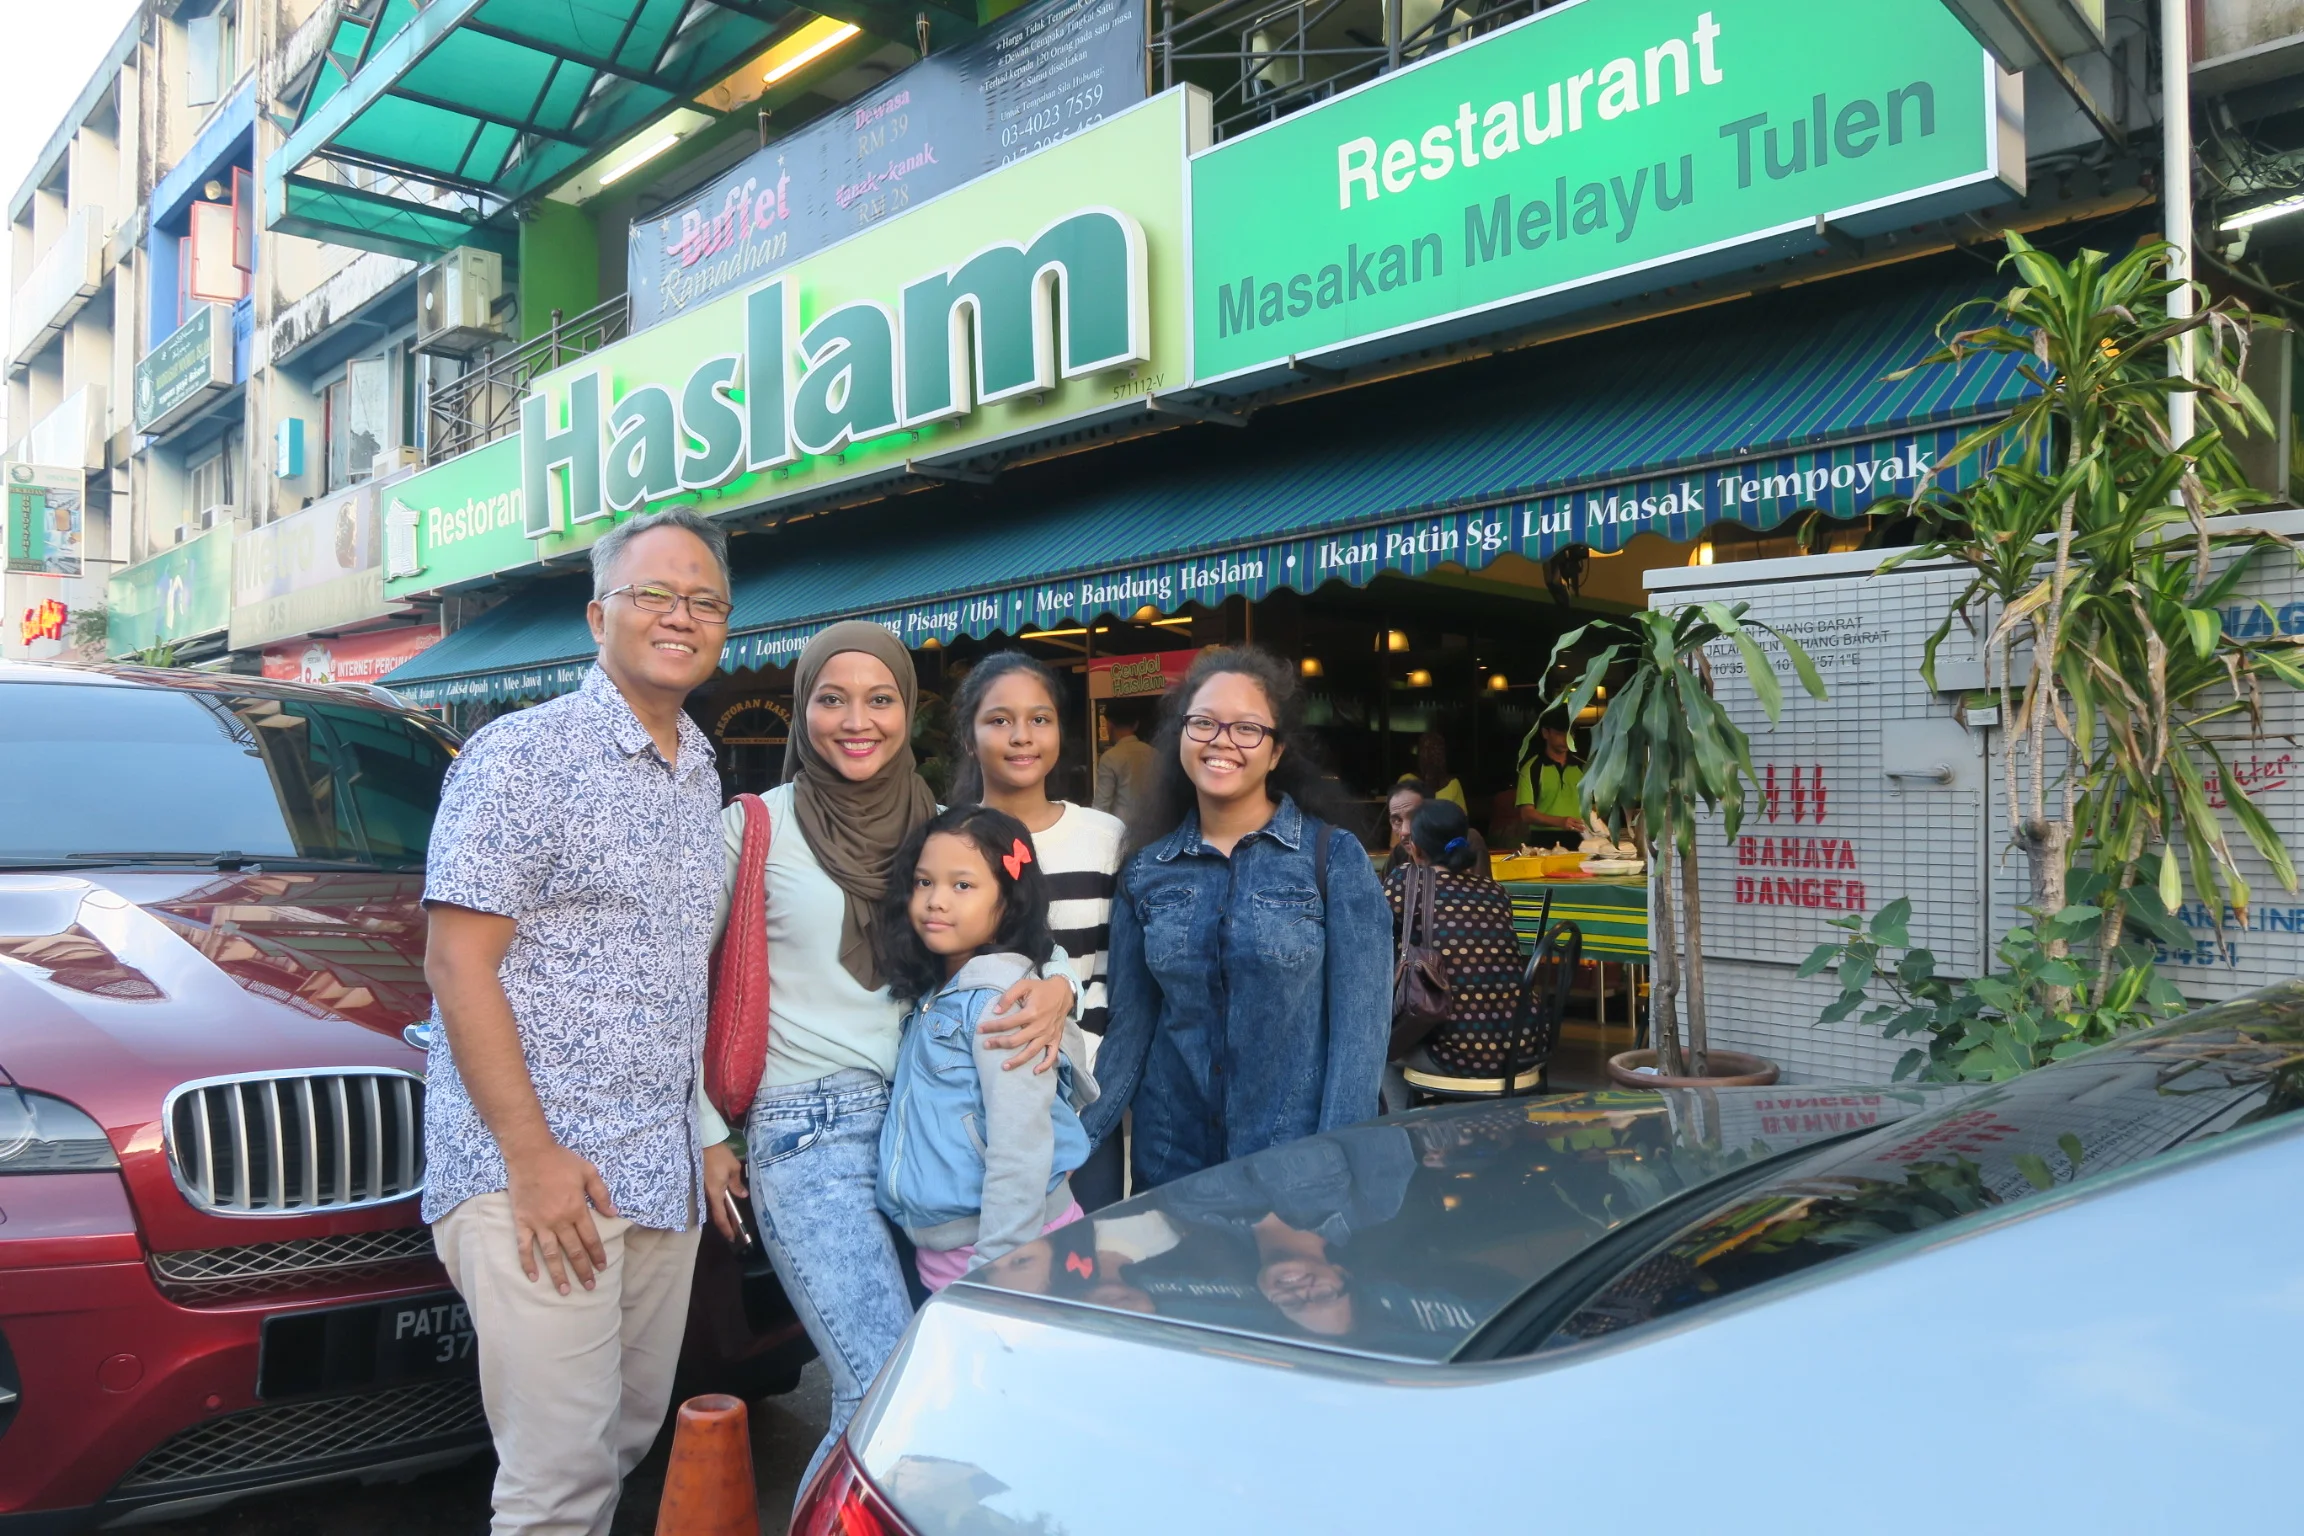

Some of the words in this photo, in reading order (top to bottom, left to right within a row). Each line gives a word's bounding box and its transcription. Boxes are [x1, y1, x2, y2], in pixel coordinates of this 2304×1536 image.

[1002, 34, 1023, 50] Harga
[1024, 20, 1046, 37] Tidak
[1047, 0, 1083, 25] Termasuk
[1004, 45, 1029, 65] Dewan
[1030, 29, 1065, 51] Cempaka
[1066, 13, 1094, 38] Tingkat
[1096, 3, 1114, 18] Satu
[984, 73, 1008, 91] Terhad
[1009, 58, 1034, 80] kepada
[1036, 51, 1049, 66] 120
[1050, 40, 1073, 58] Orang
[1074, 30, 1093, 49] pada
[1094, 22, 1110, 36] satu
[1112, 10, 1132, 28] masa
[1026, 70, 1047, 87] Surau
[1048, 51, 1088, 76] disediakan
[855, 90, 910, 130] Dewasa
[1000, 108, 1021, 122] Untuk
[1022, 89, 1056, 111] Tempahan
[1057, 82, 1071, 96] Sila
[1001, 104, 1060, 148] 03-4023
[1065, 84, 1103, 119] 7559
[1337, 10, 1724, 210] Restaurant
[858, 125, 885, 157] RM
[890, 114, 908, 142] 39
[666, 168, 790, 268] Buffet
[859, 195, 886, 227] RM
[890, 183, 910, 211] 28
[1218, 231, 1443, 338] Masakan
[1464, 153, 1695, 270] Melayu
[1718, 79, 1934, 189] Tulen
[660, 221, 787, 310] Ramadhan
[521, 204, 1150, 540] Haslam
[1113, 373, 1164, 400] 571112-V
[428, 487, 523, 549] Restoran
[1319, 537, 1379, 570] Ikan
[1385, 522, 1459, 561] Patin
[1466, 518, 1508, 552] Sg.
[1522, 502, 1572, 538] Lui
[1587, 482, 1703, 529] Masak
[1717, 443, 1935, 507] Tempoyak
[238, 521, 314, 591] Metro
[1036, 589, 1074, 612] Mee
[1081, 575, 1172, 607] Bandung
[1180, 559, 1264, 591] Haslam
[907, 609, 958, 632] Pisang
[969, 599, 999, 623] Ubi
[1818, 617, 1863, 633] BARAT
[755, 634, 809, 657] Lontong
[1706, 641, 1739, 656] JALA
[1843, 630, 1890, 646] BARAT
[337, 658, 373, 677] INTERNET
[375, 655, 413, 673] PERCU
[503, 677, 520, 691] Mee
[521, 673, 542, 689] Jawa
[557, 668, 575, 683] Mee
[1110, 654, 1161, 679] Cendol
[1112, 673, 1166, 697] Haslam
[446, 682, 468, 697] Laksa
[469, 679, 489, 697] Opah
[714, 698, 761, 737] RESTORAN
[1739, 836, 1856, 870] BAHAYA
[1736, 876, 1866, 912] DANGER
[395, 1303, 468, 1340] PATR
[436, 1330, 475, 1363] 37
